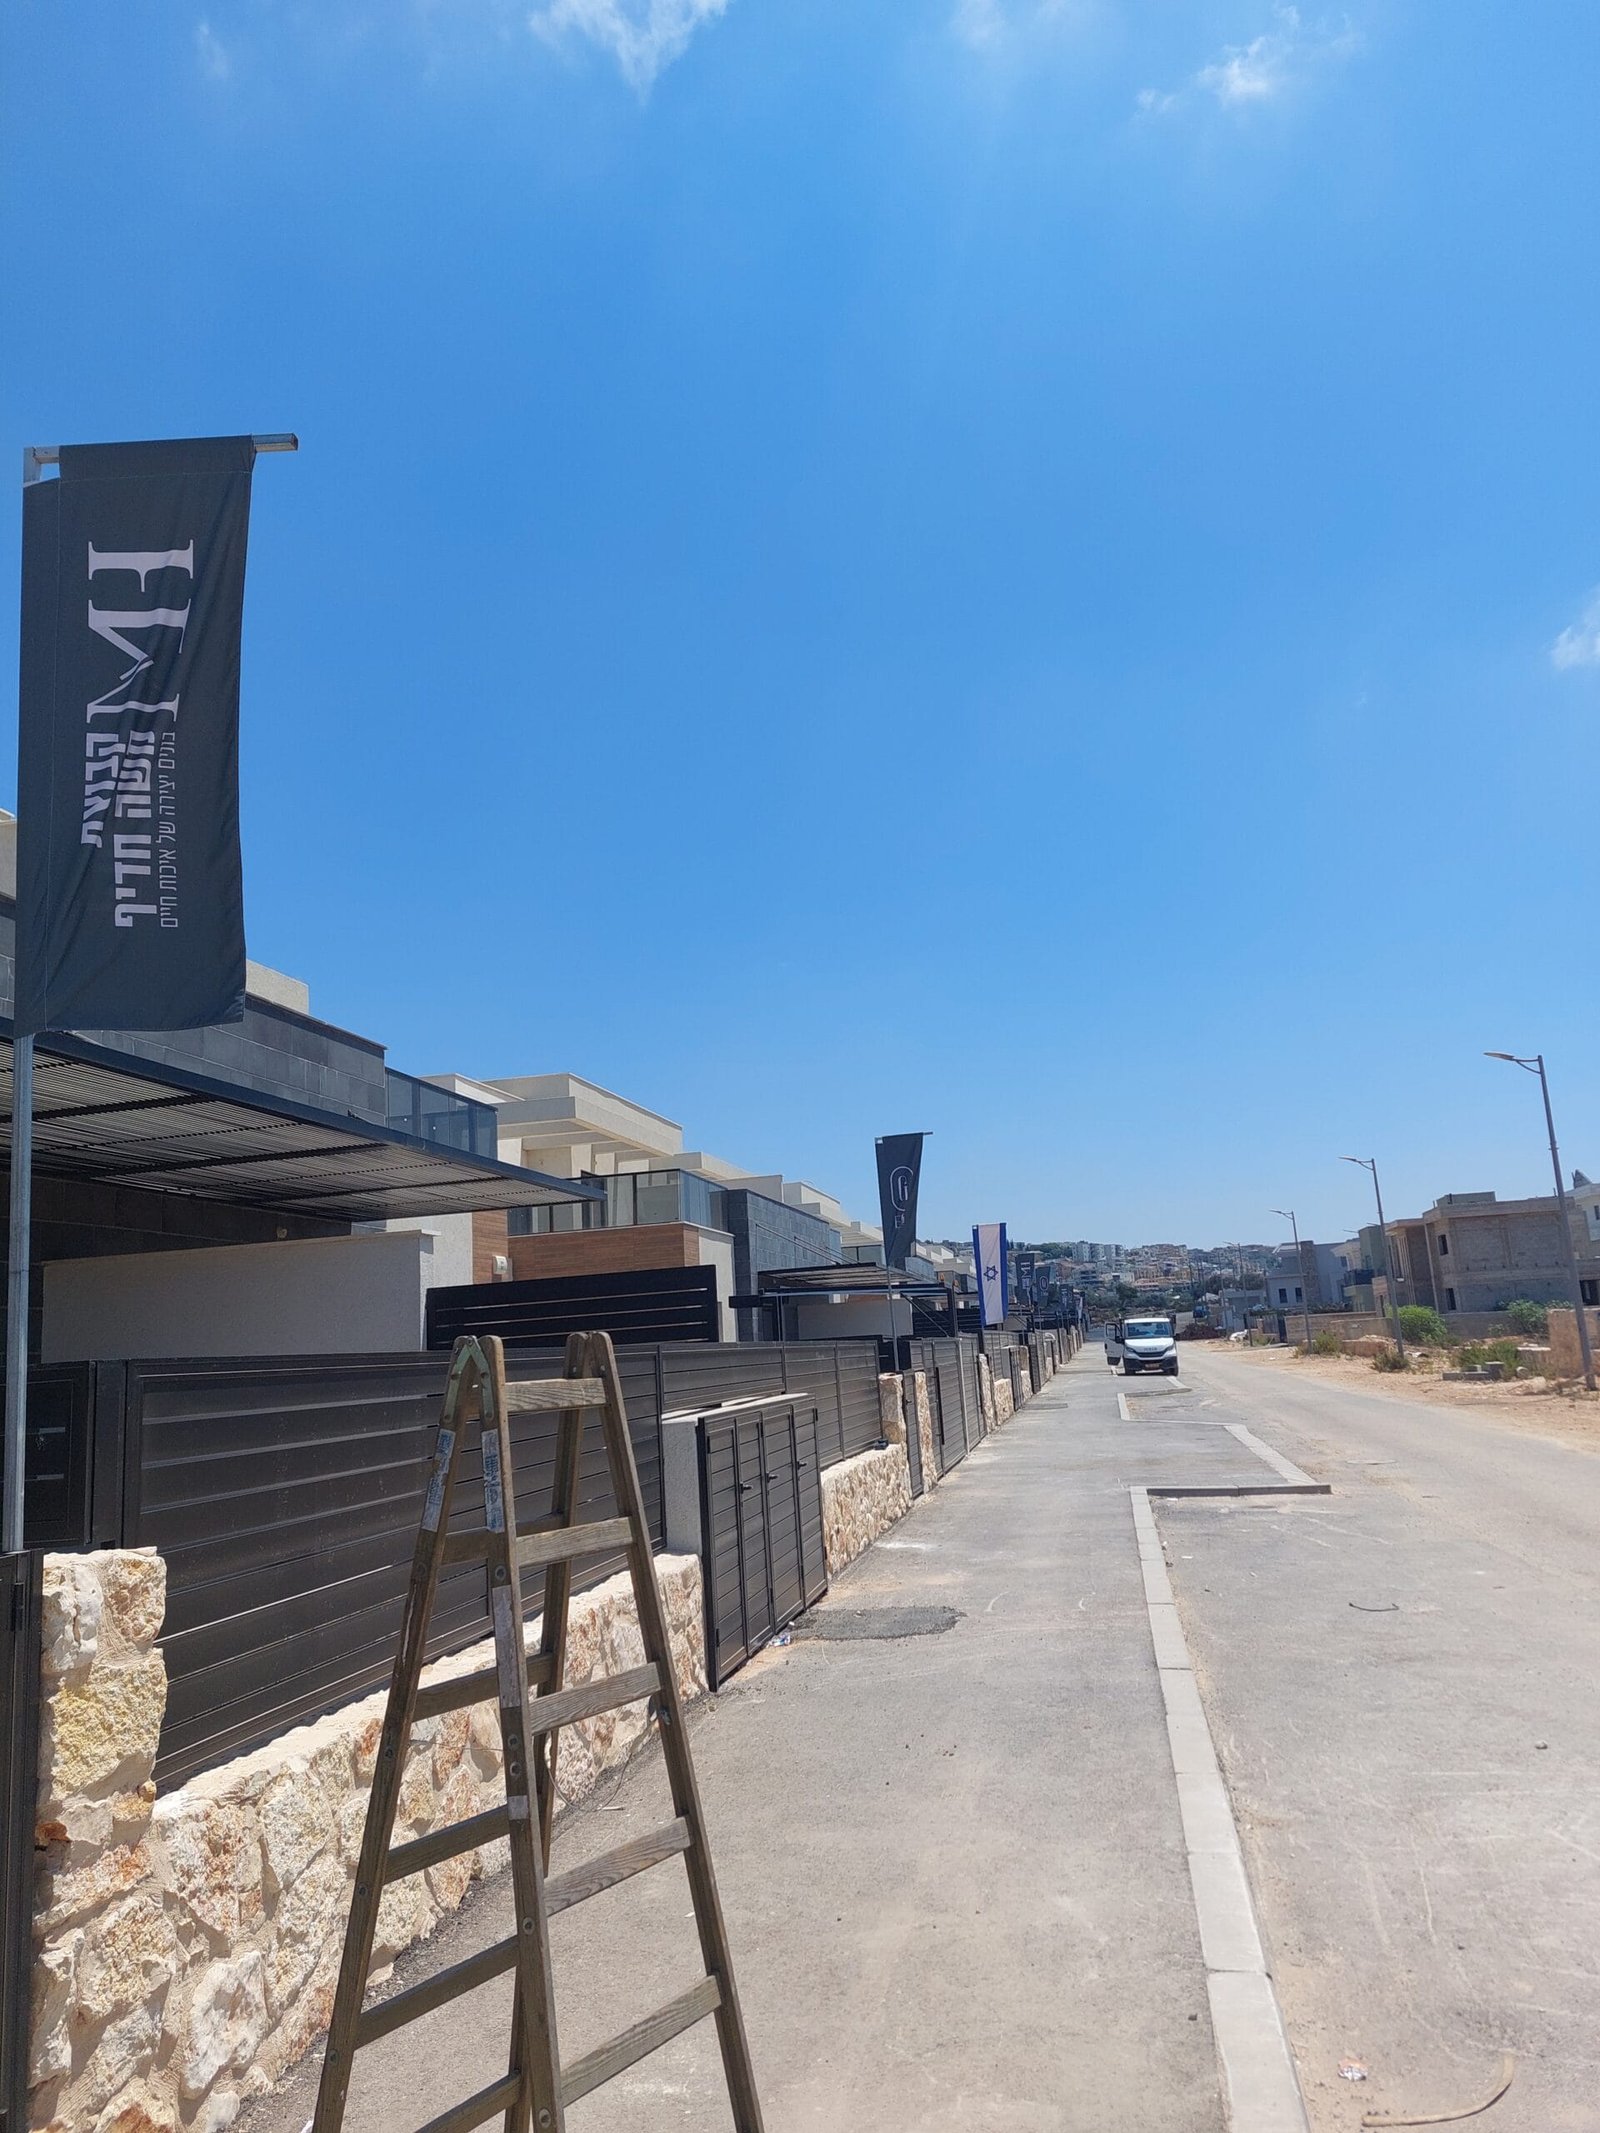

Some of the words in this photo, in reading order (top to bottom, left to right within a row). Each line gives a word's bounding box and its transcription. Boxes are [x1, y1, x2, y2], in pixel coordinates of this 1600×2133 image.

[86, 539, 194, 723] MH
[158, 732, 176, 769] בונים
[80, 732, 126, 848] קבוצת
[114, 730, 156, 818] משה
[157, 774, 176, 816] יצירה
[156, 821, 177, 844] של
[113, 834, 158, 928] חדיף
[159, 849, 177, 891] איכות
[160, 896, 179, 928] חיים
